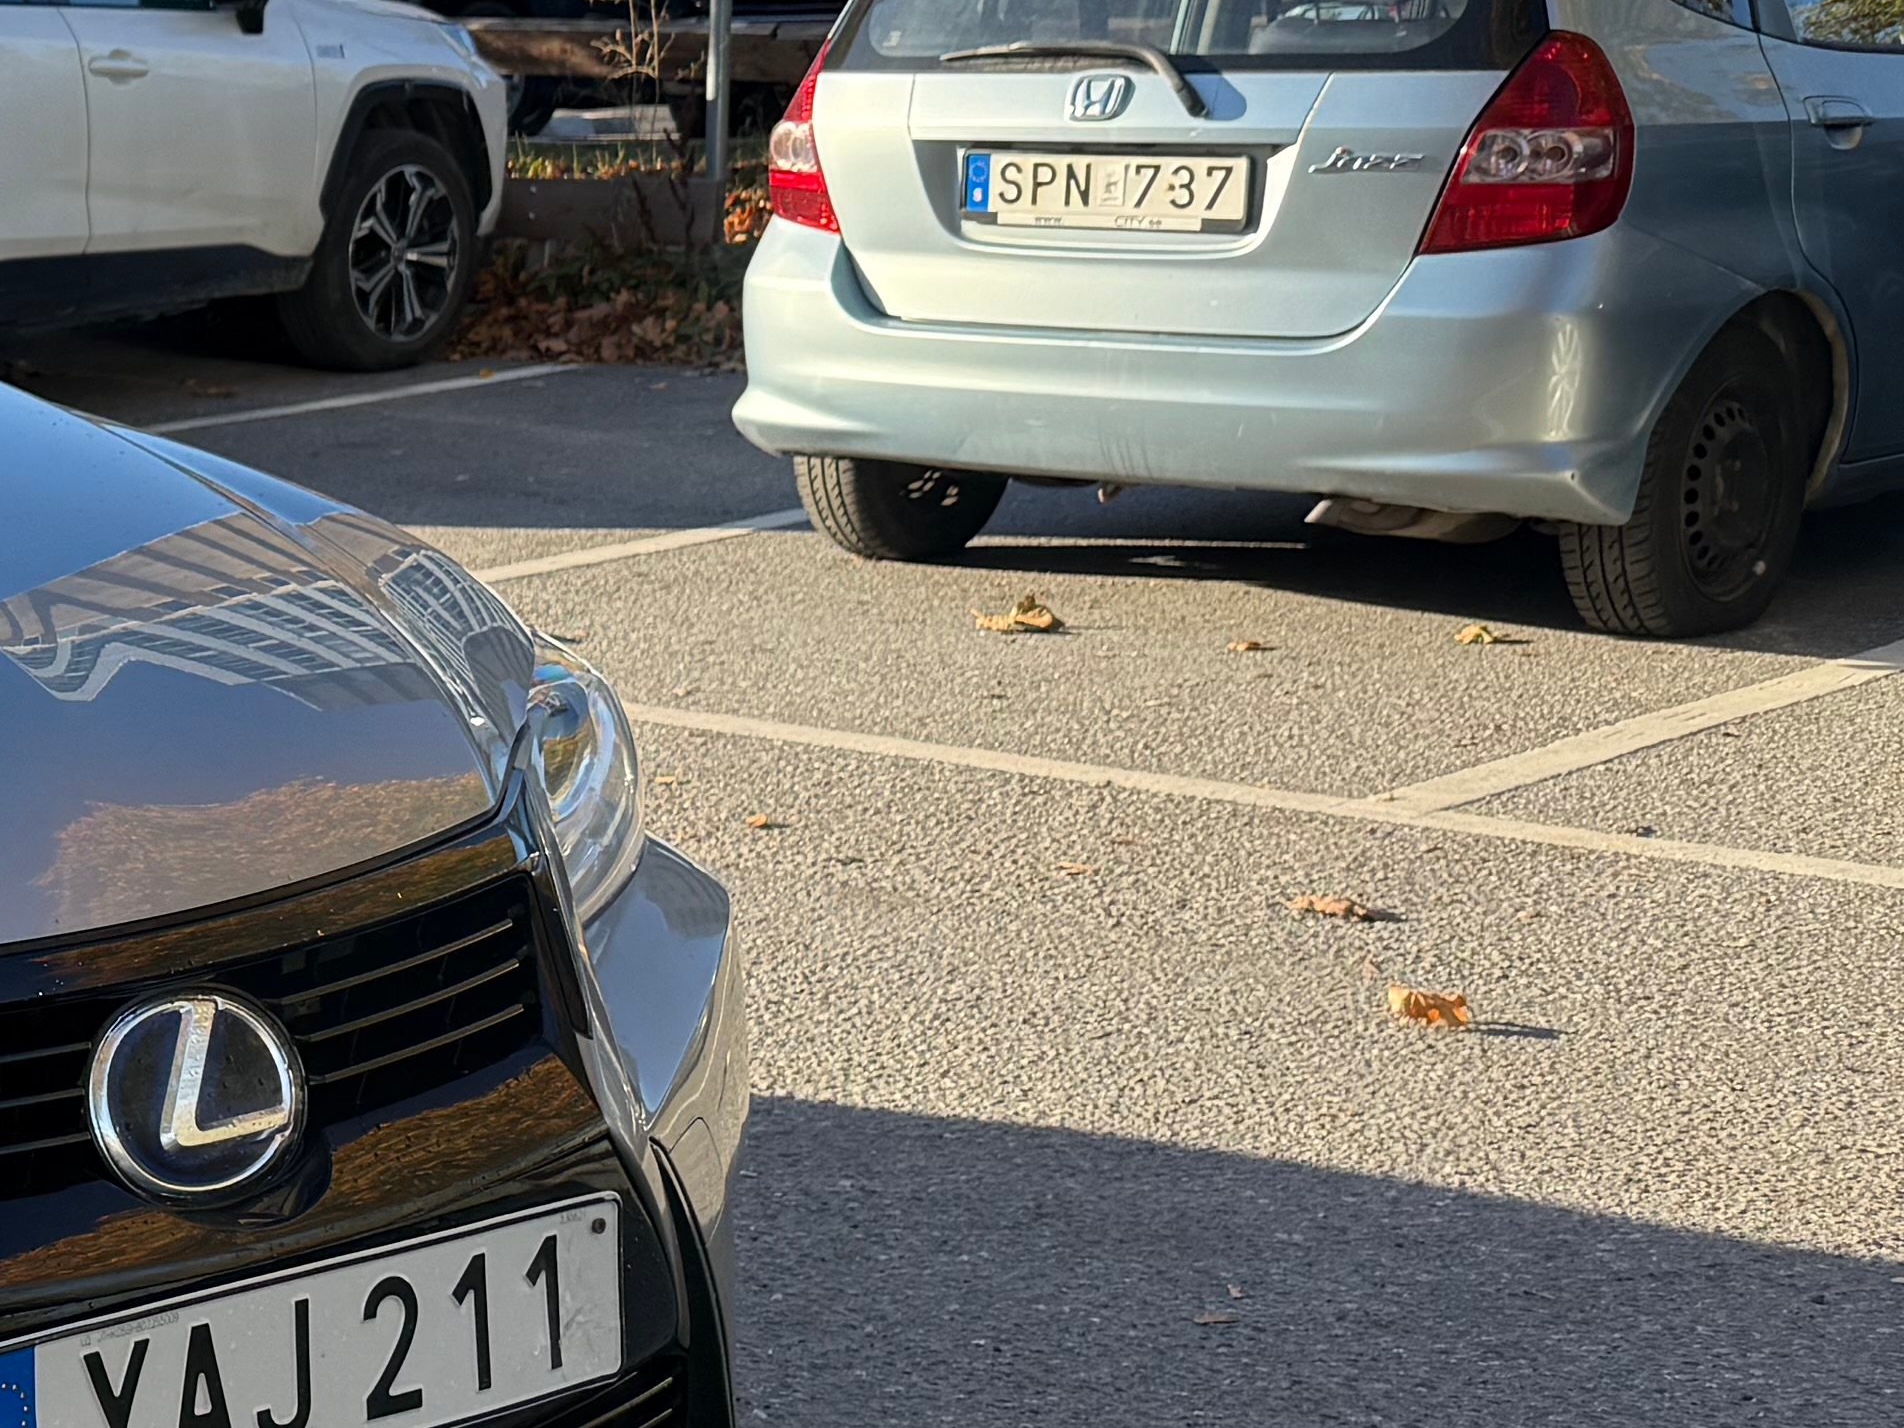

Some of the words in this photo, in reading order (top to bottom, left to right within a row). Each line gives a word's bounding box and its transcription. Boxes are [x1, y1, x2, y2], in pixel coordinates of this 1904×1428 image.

[998, 162, 1092, 207] SPN
[1133, 163, 1235, 211] 737
[362, 1234, 562, 1421] 211
